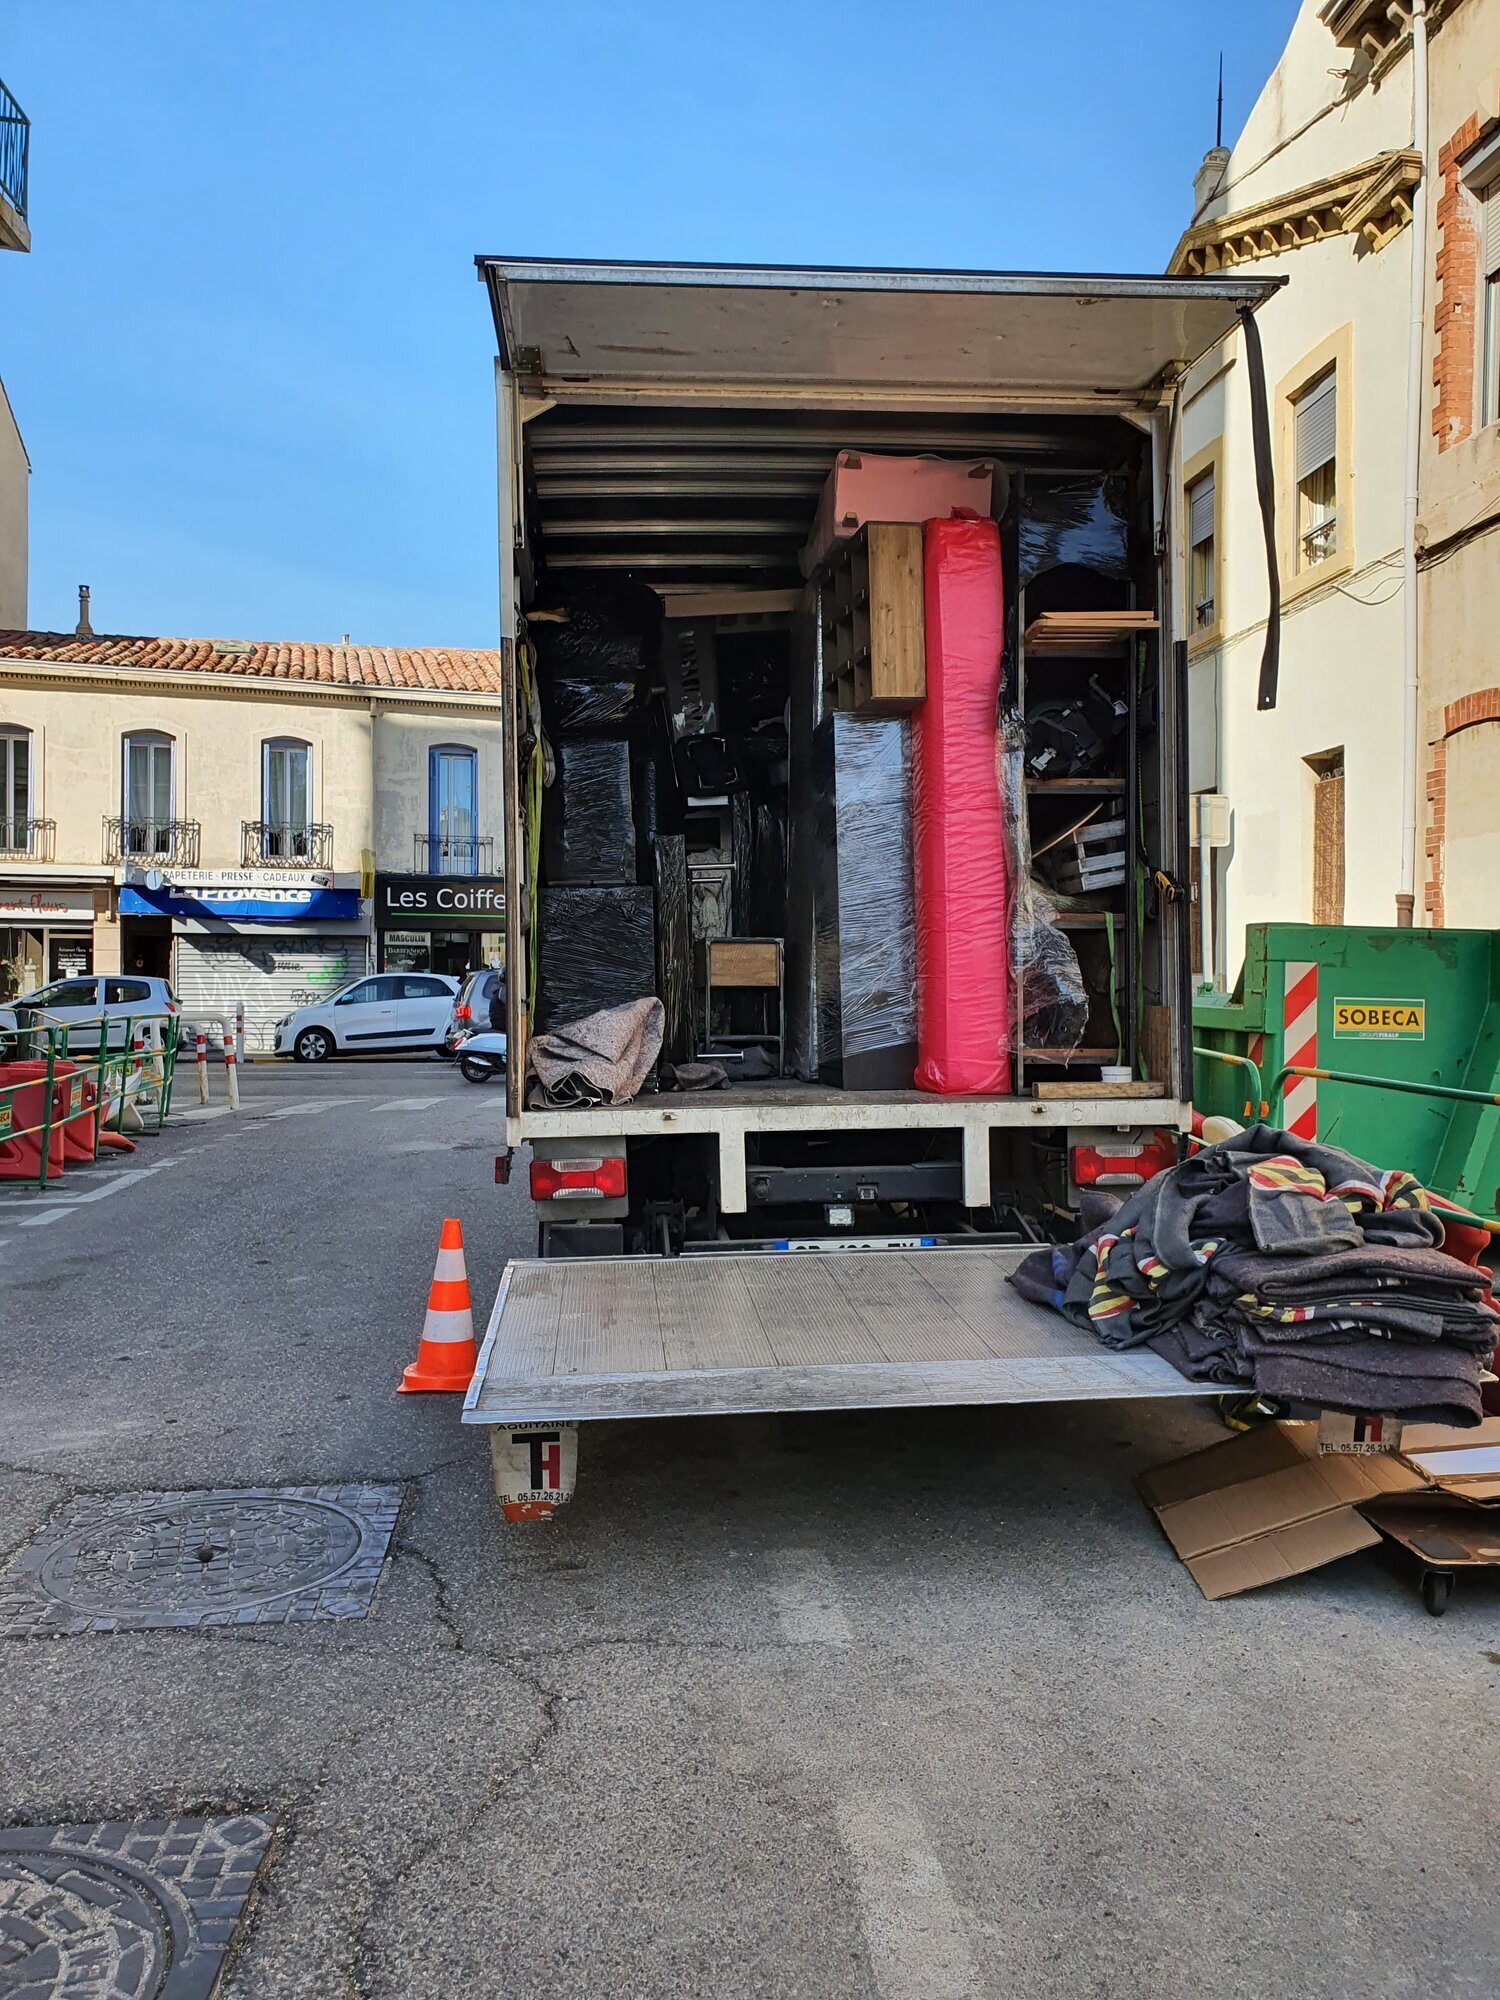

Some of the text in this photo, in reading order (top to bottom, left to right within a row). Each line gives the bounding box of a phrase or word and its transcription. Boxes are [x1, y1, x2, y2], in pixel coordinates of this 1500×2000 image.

[164, 871, 214, 881] PAPETERIE
[220, 872, 254, 882] PRESSE
[262, 872, 306, 882] CADEAUX
[0, 893, 69, 914] ent fleurs
[386, 887, 506, 909] Les Coiffe
[389, 934, 426, 943] MASCULIN
[1339, 1009, 1419, 1026] SOBECA
[0, 1112, 10, 1122] ECA
[497, 1421, 574, 1431] AQUITAINE
[1320, 1443, 1388, 1454] TEL. 05.57.26.21
[500, 1494, 516, 1505] TEL.
